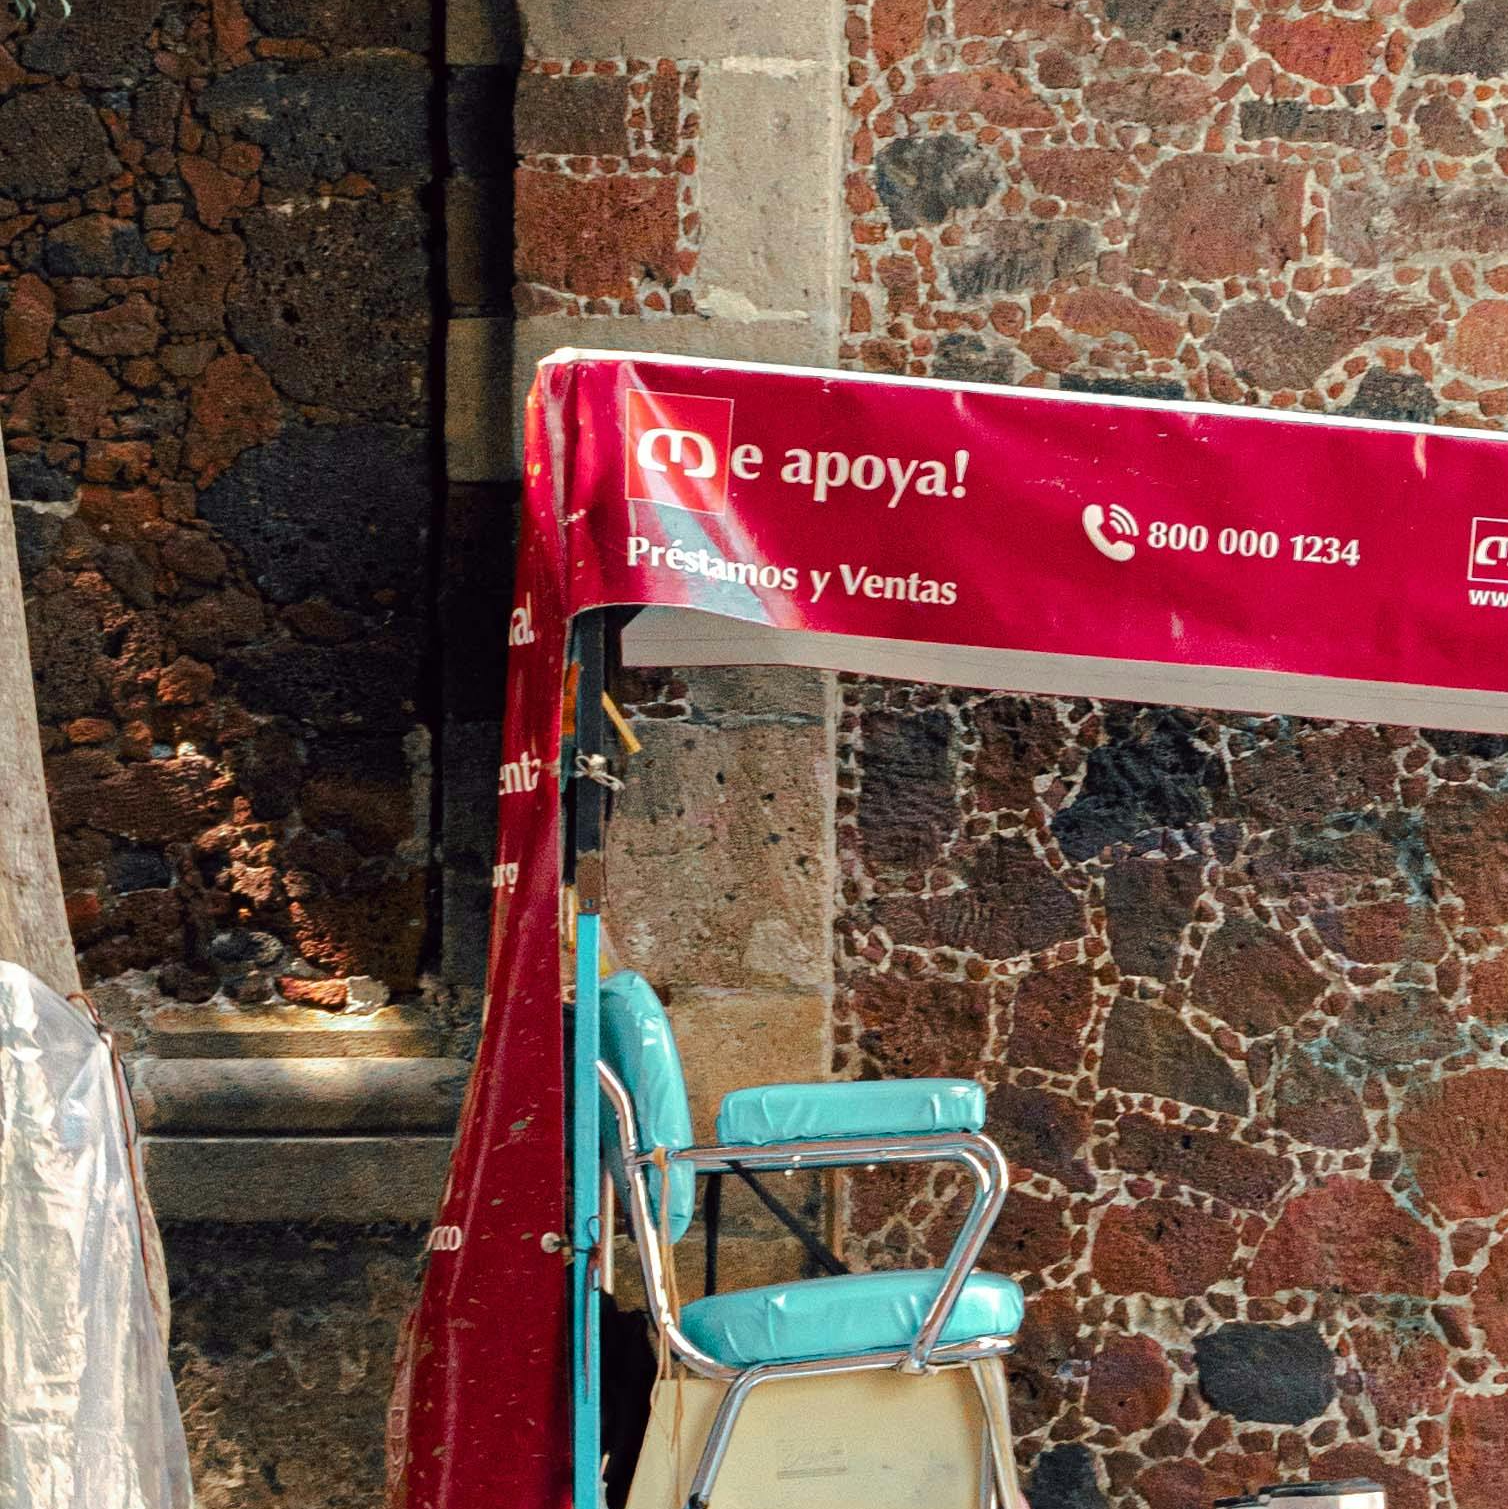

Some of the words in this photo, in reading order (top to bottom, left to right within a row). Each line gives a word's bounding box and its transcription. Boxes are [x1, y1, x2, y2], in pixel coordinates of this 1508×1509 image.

[780, 448, 970, 509] apoya!
[626, 535, 799, 591] Préstamos
[809, 569, 832, 604] y
[838, 563, 958, 606] Ventas
[1146, 520, 1210, 553] 800
[1217, 527, 1280, 559] 000
[1289, 534, 1361, 567] 1234
